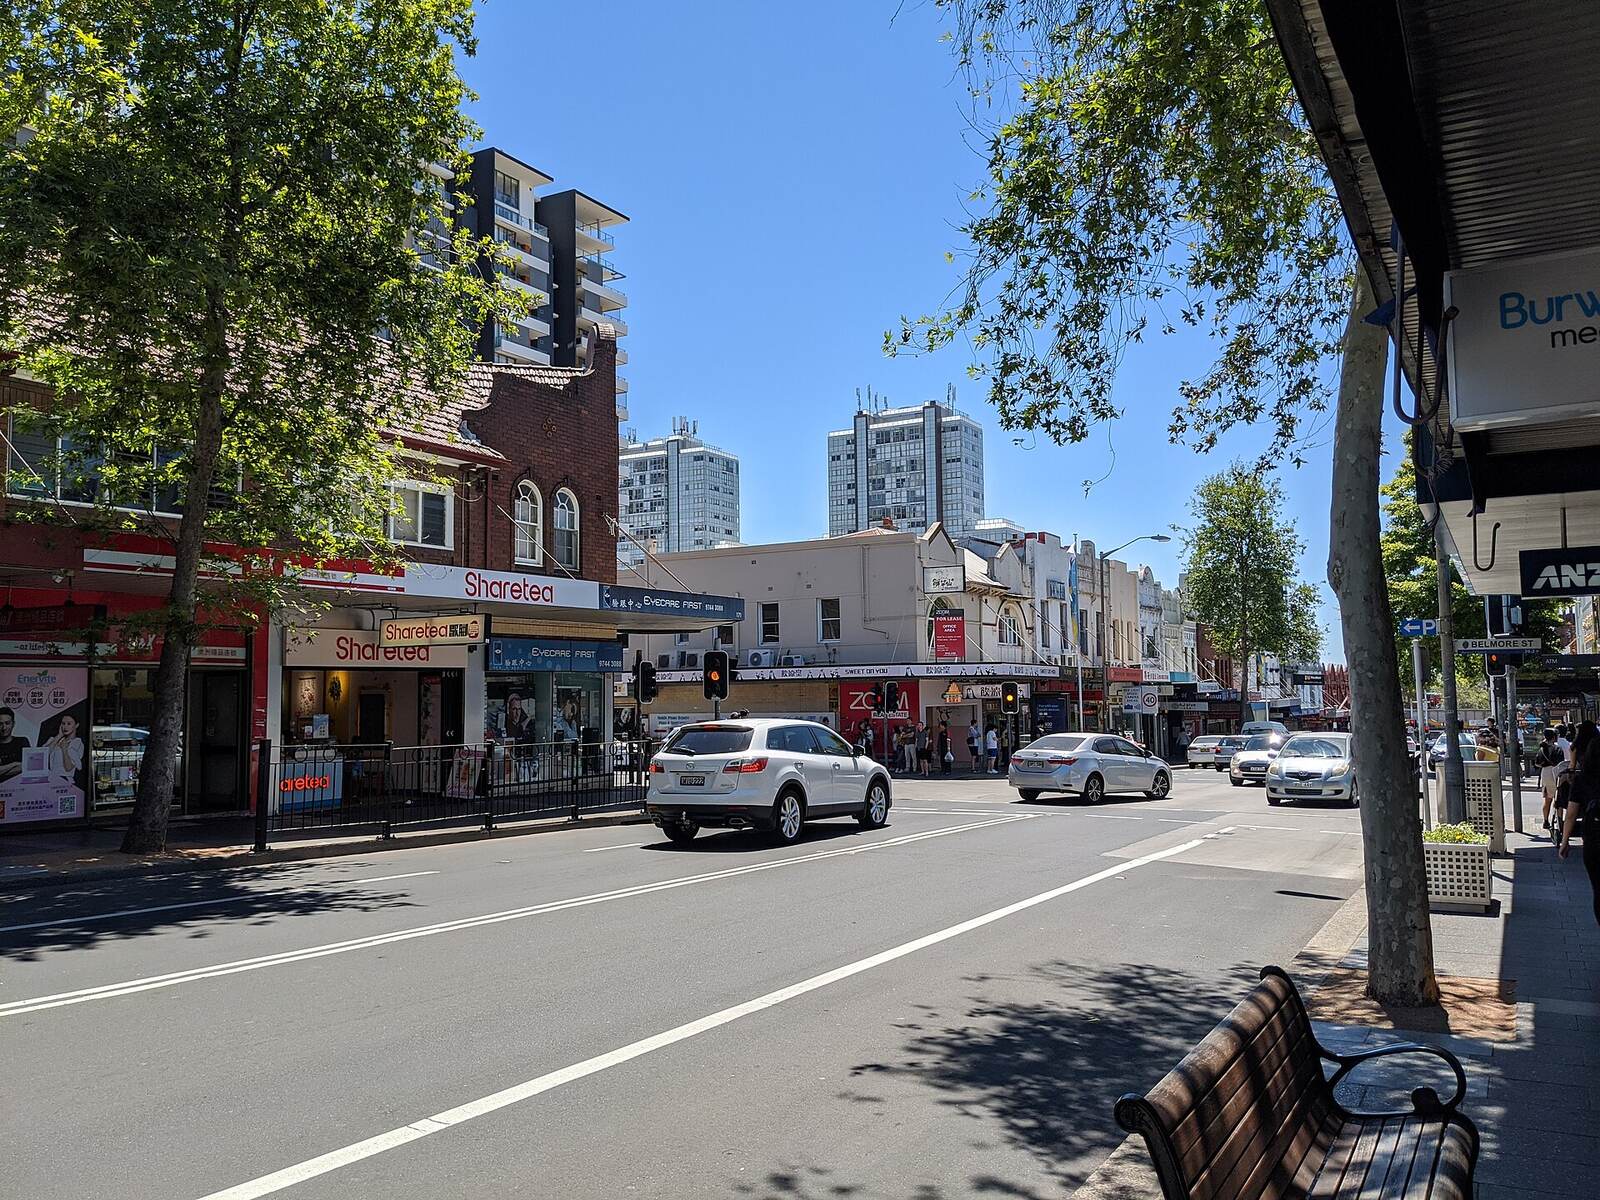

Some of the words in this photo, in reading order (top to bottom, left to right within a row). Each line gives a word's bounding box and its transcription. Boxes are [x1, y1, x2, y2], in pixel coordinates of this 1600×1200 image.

[1551, 326, 1600, 348] me
[1532, 563, 1600, 589] ANZ
[464, 570, 553, 603] Sharetea
[682, 601, 702, 610] FIRST
[386, 622, 448, 640] Sharetea
[1422, 619, 1436, 635] P
[336, 637, 429, 661] Sharetea
[1471, 640, 1519, 648] BELMORE
[574, 650, 596, 659] FIRST
[849, 691, 909, 710] ZOM
[280, 773, 330, 791] aretea
